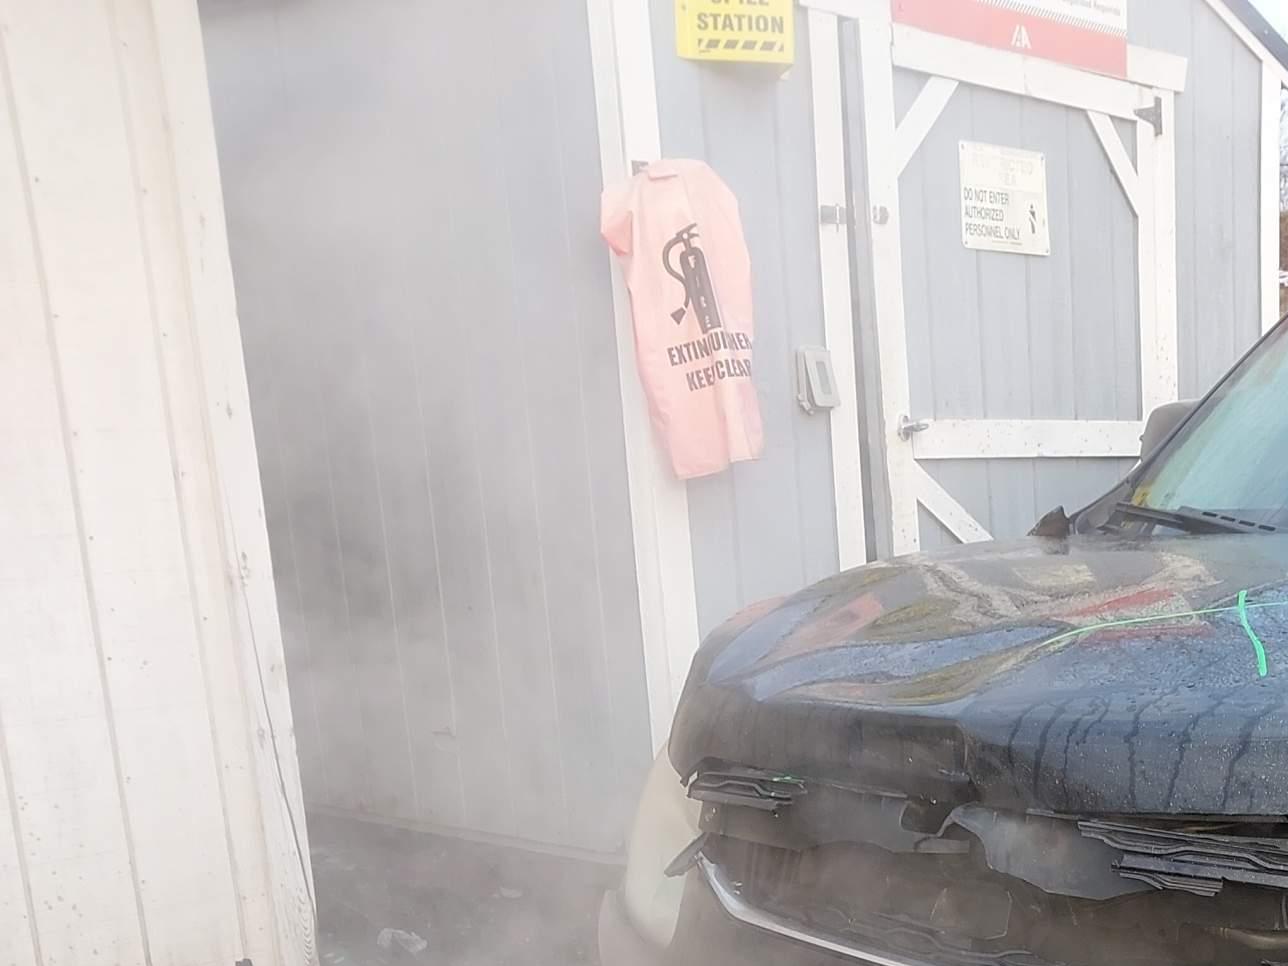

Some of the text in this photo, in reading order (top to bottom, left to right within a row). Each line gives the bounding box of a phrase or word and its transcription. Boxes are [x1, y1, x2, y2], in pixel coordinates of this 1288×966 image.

[697, 13, 784, 34] STATION
[963, 187, 1009, 205] DO NOT ENTER
[964, 205, 1004, 221] AUTHORIZED
[965, 222, 1020, 241] PERSONNEL ONLY
